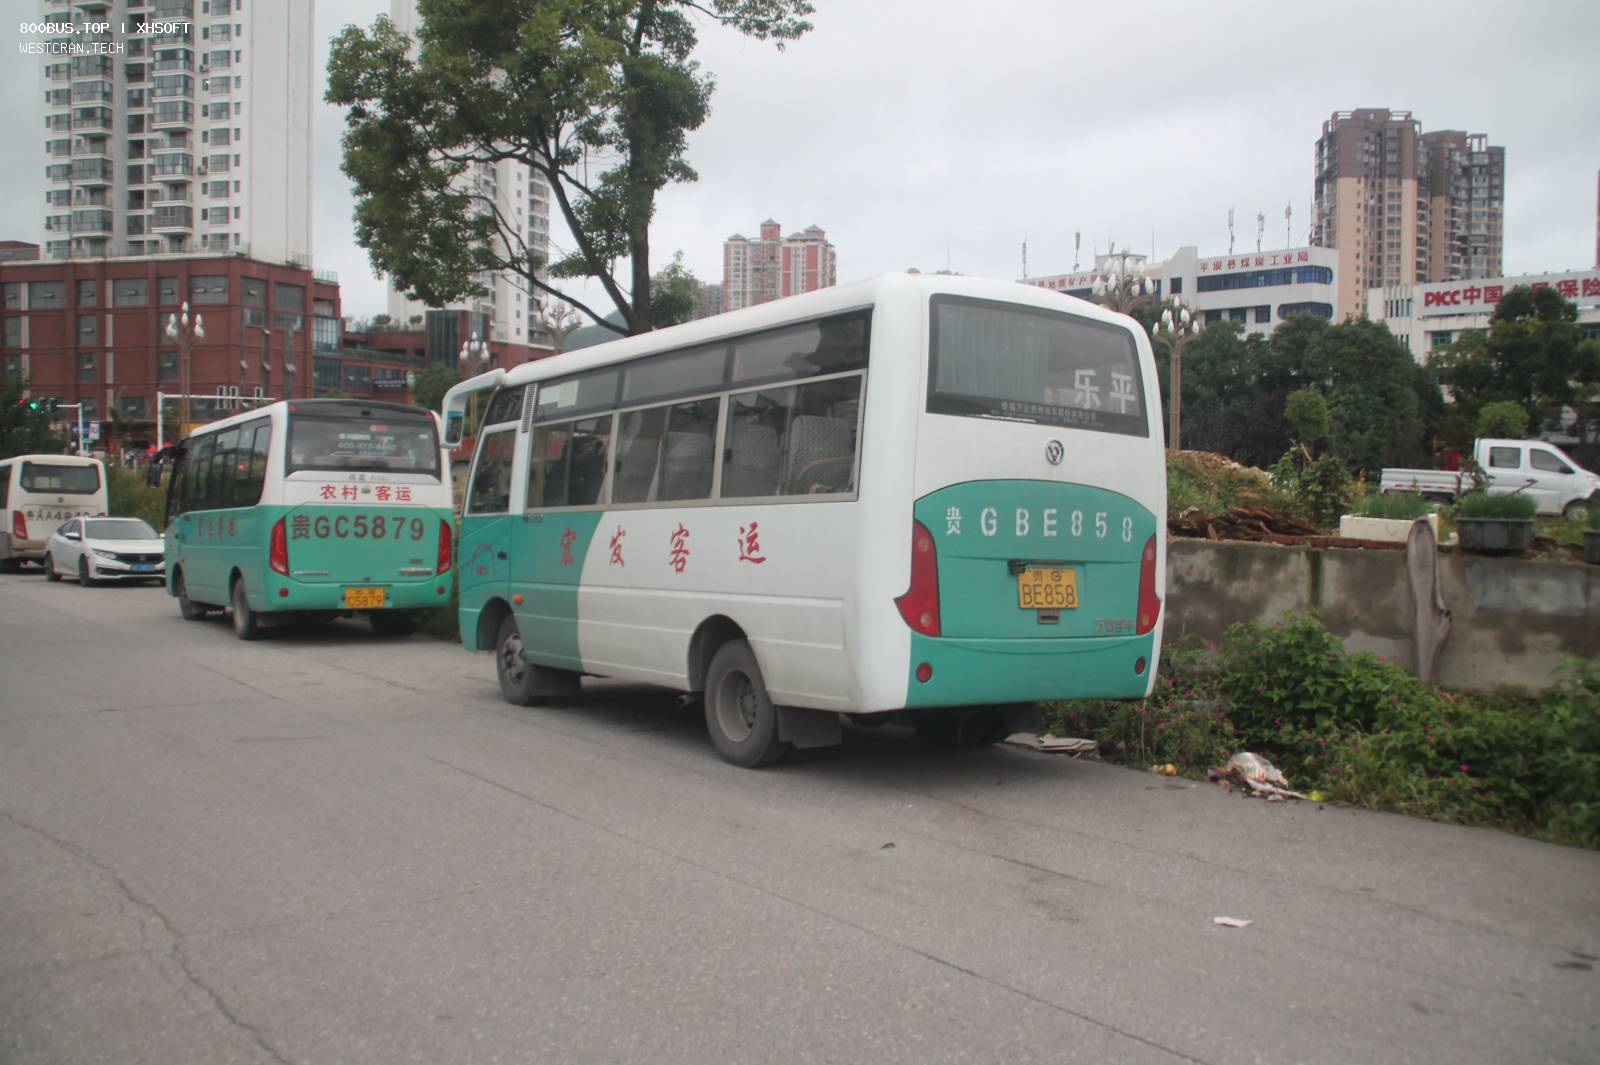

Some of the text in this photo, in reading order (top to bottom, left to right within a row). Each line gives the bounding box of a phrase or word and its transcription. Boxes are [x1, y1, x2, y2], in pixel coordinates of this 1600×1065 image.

[1073, 368, 1137, 415] 乐平
[291, 514, 425, 541] 贵GC5879
[945, 506, 1133, 543] 贵GBE858
[1022, 584, 1075, 605] BE858
